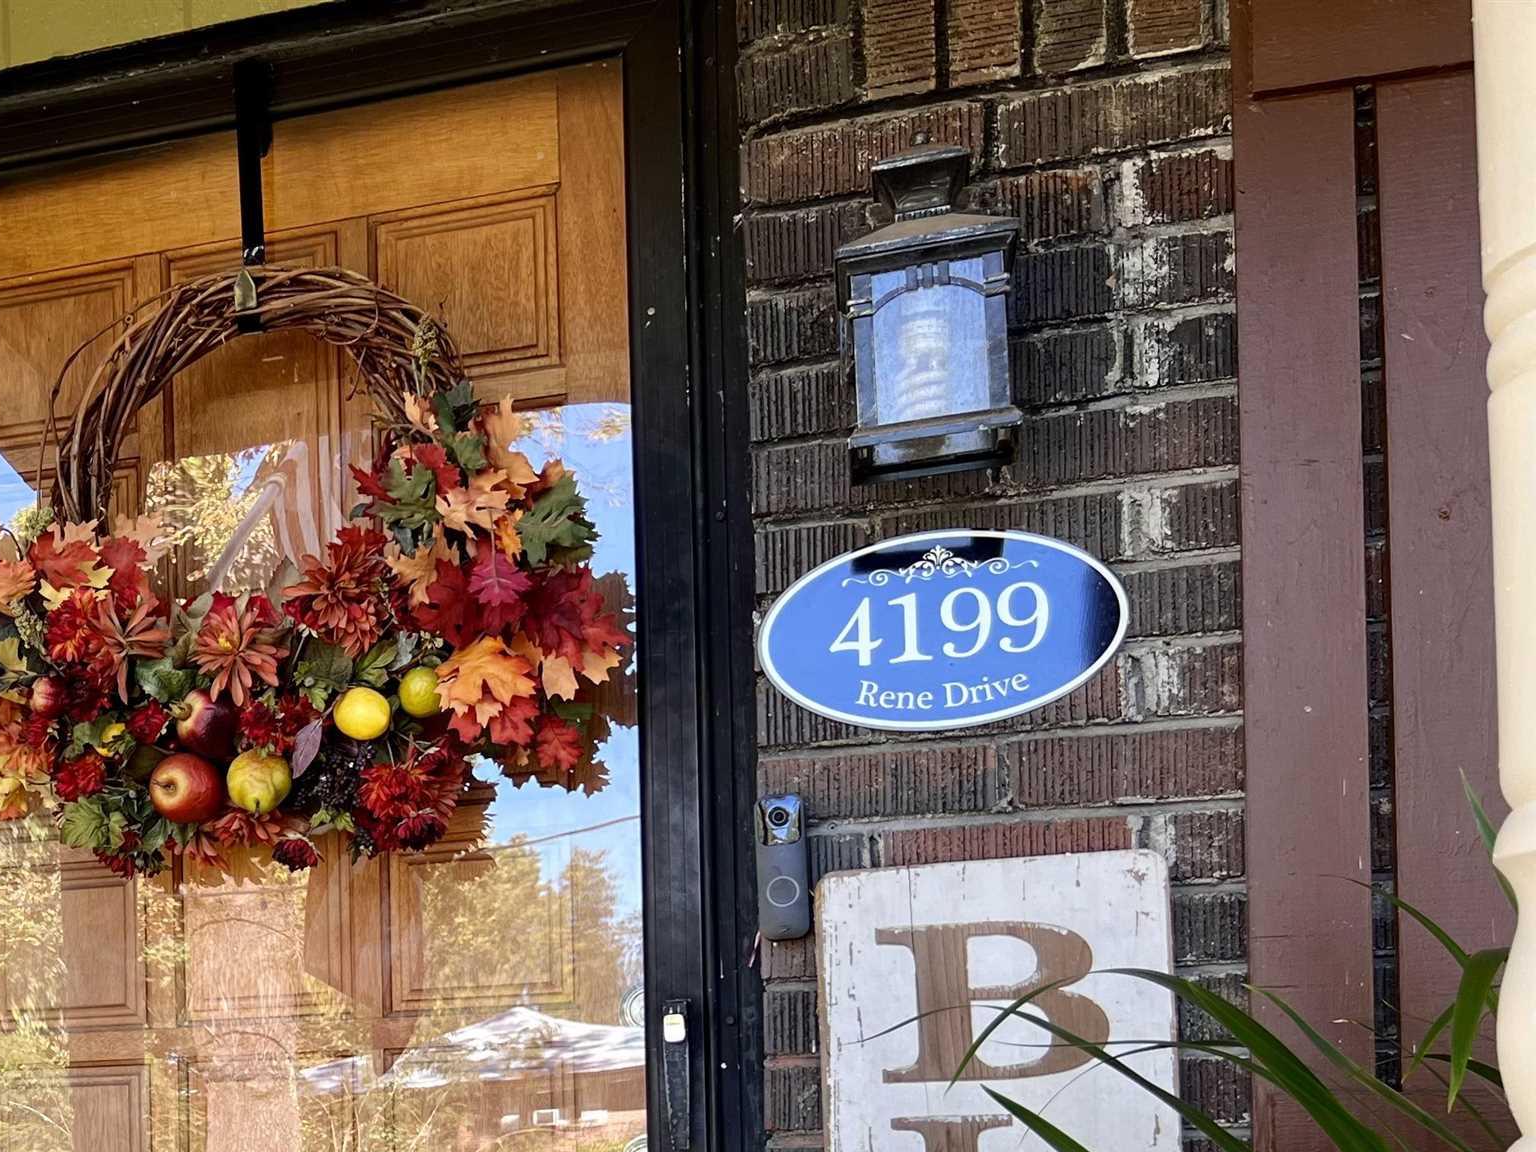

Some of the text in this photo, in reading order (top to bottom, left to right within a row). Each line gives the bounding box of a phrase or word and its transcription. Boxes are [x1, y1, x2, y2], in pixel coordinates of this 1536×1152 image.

[829, 581, 1050, 667] 4199
[855, 673, 1031, 711] Rene Drive
